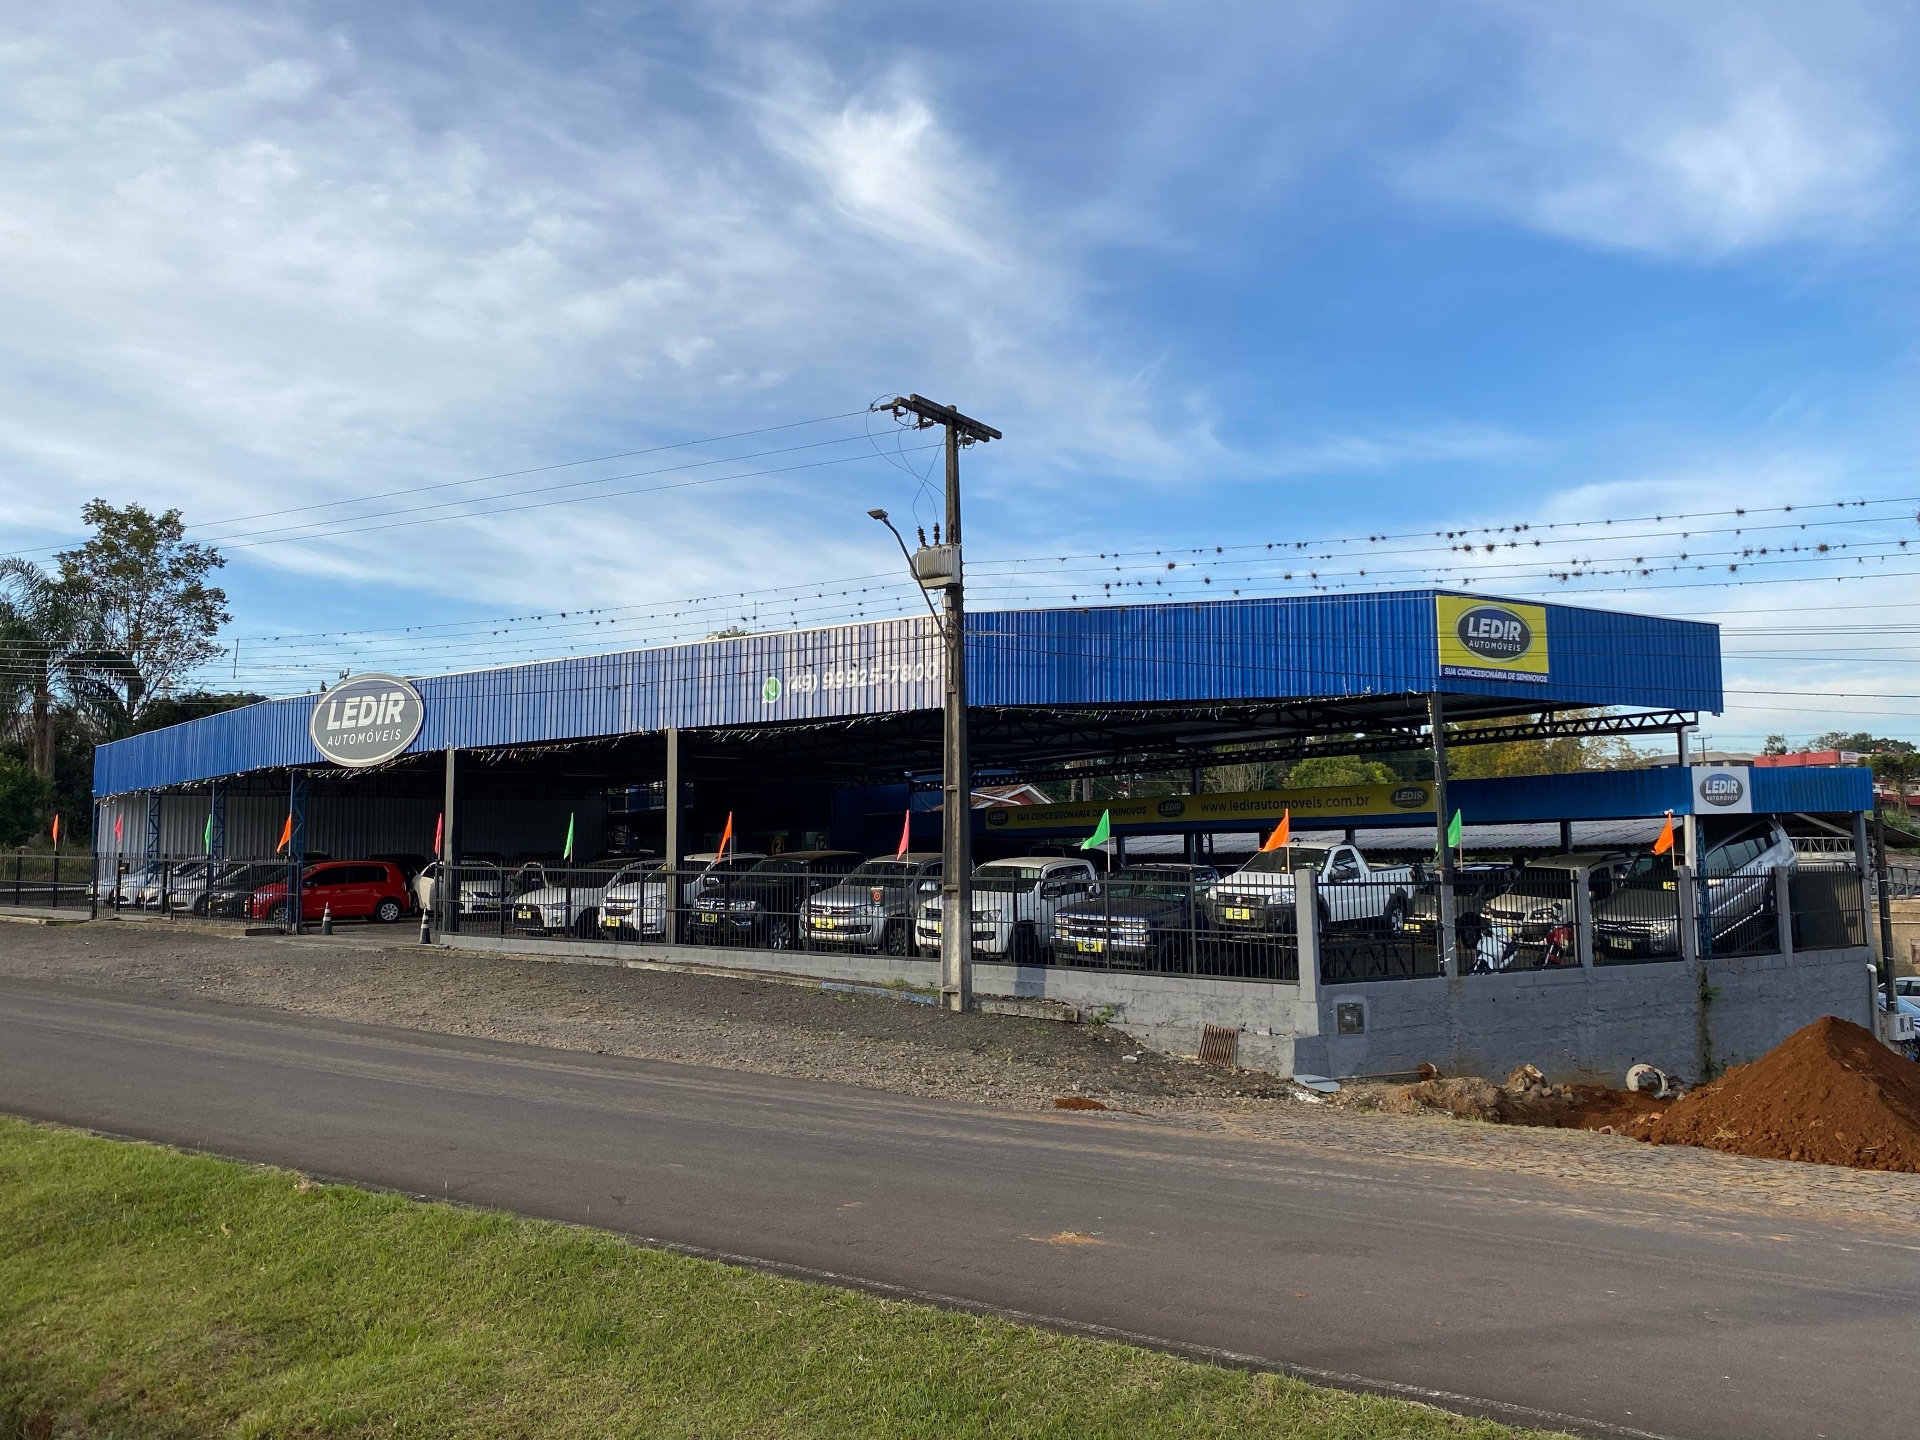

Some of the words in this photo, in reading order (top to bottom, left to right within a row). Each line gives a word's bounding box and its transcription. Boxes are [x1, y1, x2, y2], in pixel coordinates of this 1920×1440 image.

[1467, 616, 1522, 641] LEDIR
[1468, 640, 1521, 652] AUTOMÓVEIS
[1444, 667, 1457, 675] SUA
[1457, 668, 1507, 680] CONCESSIONÁRIA
[1516, 673, 1548, 683] SEMINOVOS
[786, 674, 818, 697] (49)
[327, 692, 405, 730] LEDIR
[326, 729, 401, 746] AUTOMÓVEIS
[1705, 780, 1738, 794] LEDIR
[1200, 793, 1370, 813] www.ledirautomoveis.com.br
[1395, 790, 1424, 801] LEDIR
[1017, 812, 1029, 820] SUA
[1092, 808, 1102, 817] DE
[1106, 806, 1147, 817] EMINOVOS
[1160, 802, 1182, 811] LEDIR
